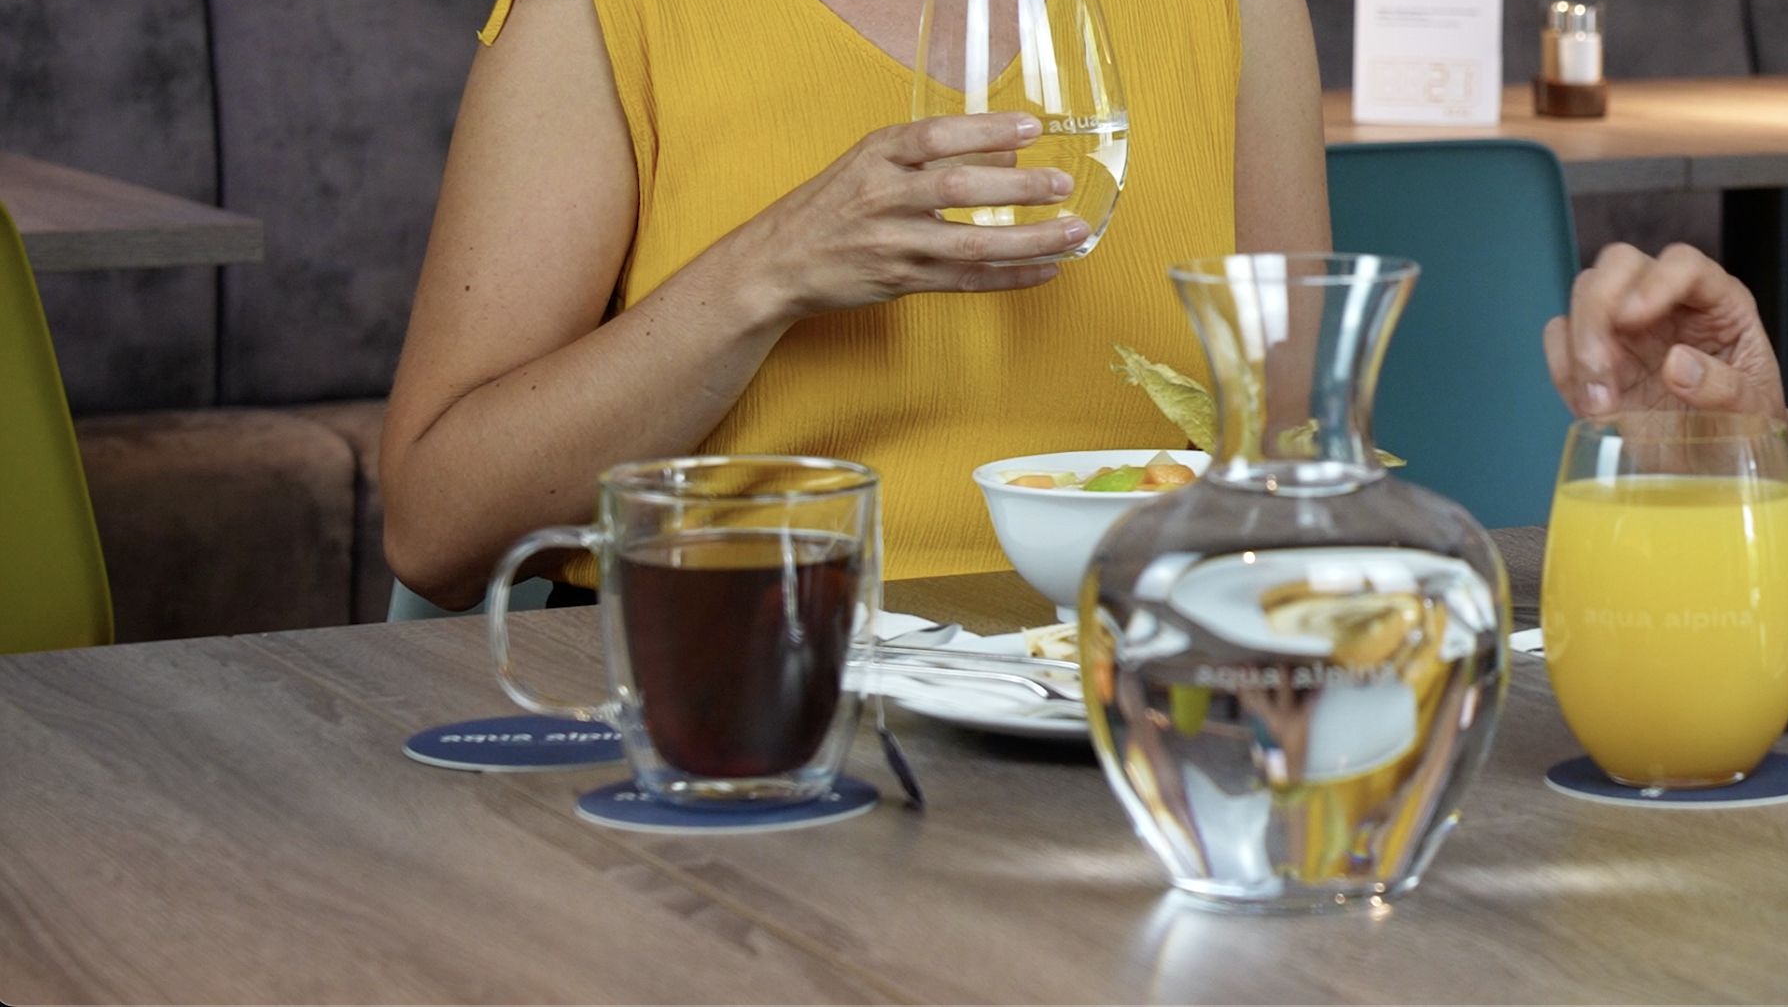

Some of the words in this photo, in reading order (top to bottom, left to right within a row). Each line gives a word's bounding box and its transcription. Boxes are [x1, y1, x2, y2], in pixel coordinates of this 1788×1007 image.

[1049, 114, 1100, 134] aqua
[1583, 608, 1651, 631] aqua
[1664, 607, 1754, 633] alpina
[1195, 663, 1280, 691] aqua
[439, 733, 533, 744] aqua
